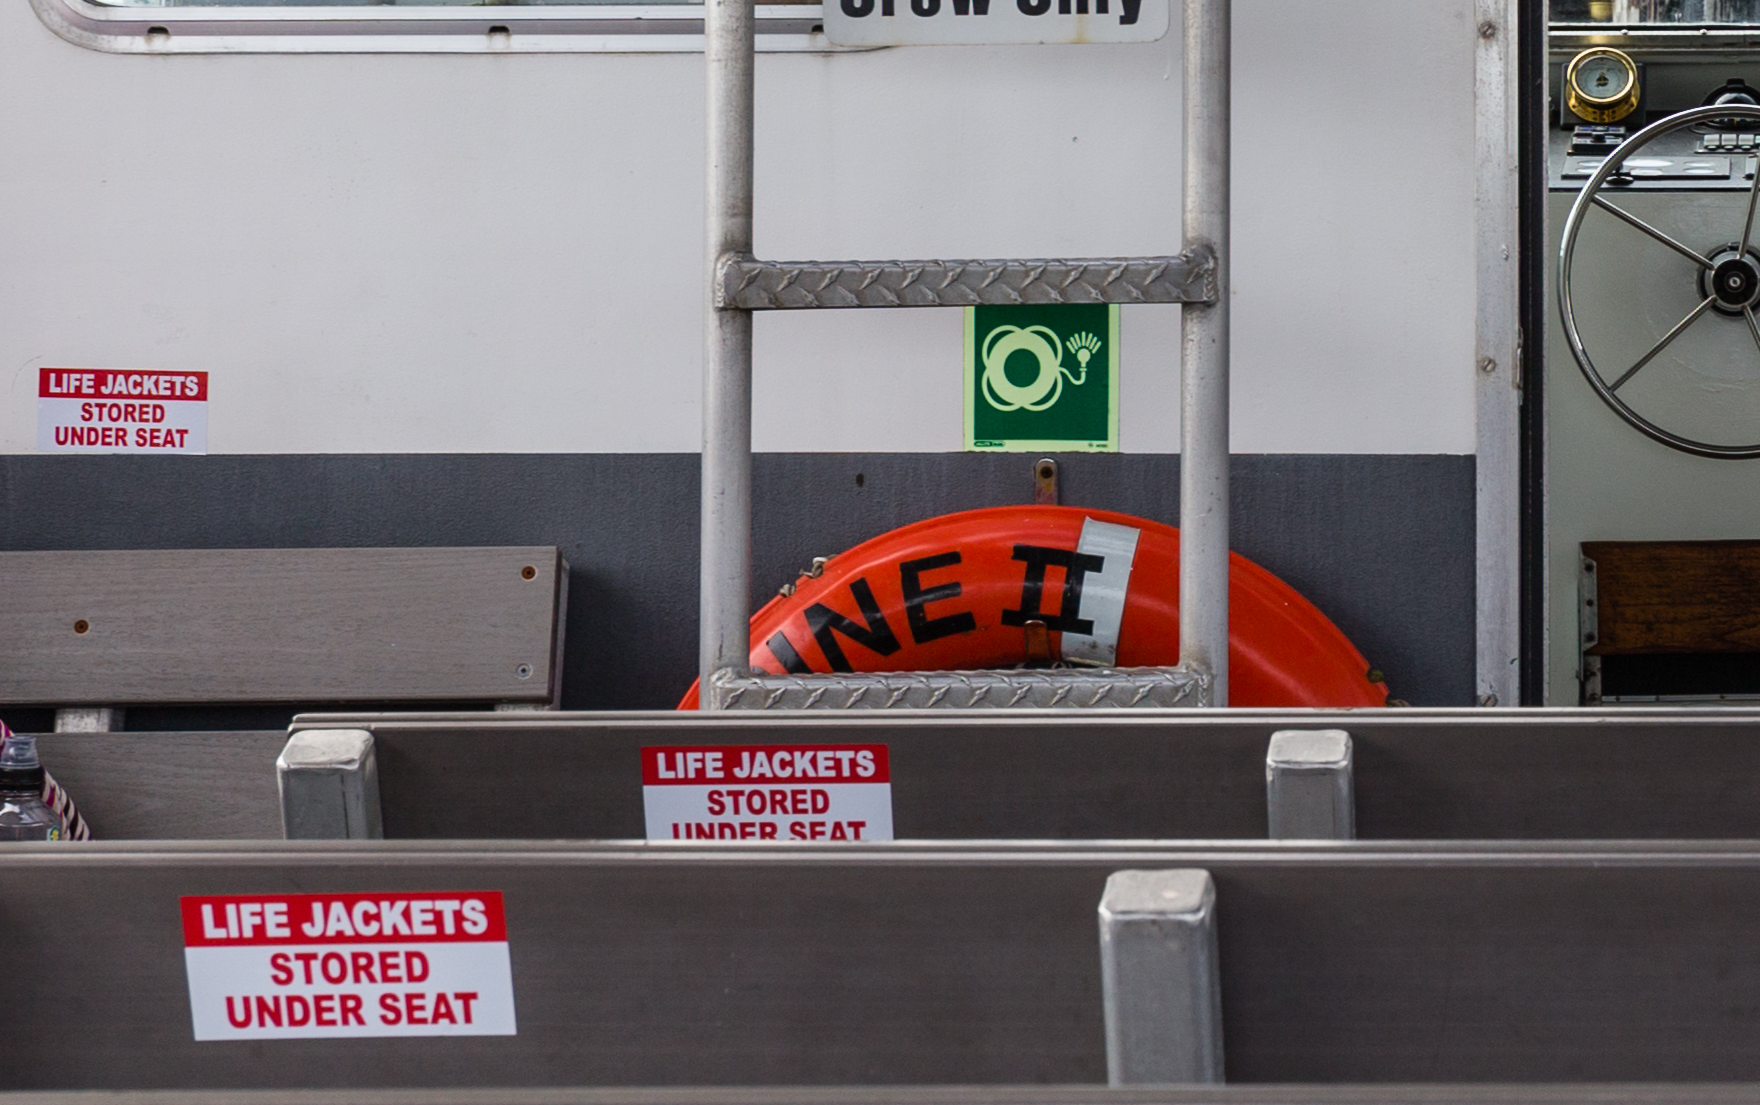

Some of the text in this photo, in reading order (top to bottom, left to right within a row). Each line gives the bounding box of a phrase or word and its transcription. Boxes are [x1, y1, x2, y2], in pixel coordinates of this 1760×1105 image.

[49, 373, 199, 396] LIFE JACKETS
[81, 402, 165, 423] STORED
[55, 426, 189, 448] UNDER SEAT
[656, 750, 876, 779] LIFE JACKETS
[707, 789, 830, 816] STORED
[672, 820, 867, 840] UNDER SEAT
[201, 899, 488, 939] LIFE JACKETS
[270, 951, 429, 986] STORED
[226, 992, 478, 1029] UNDER SEAT
